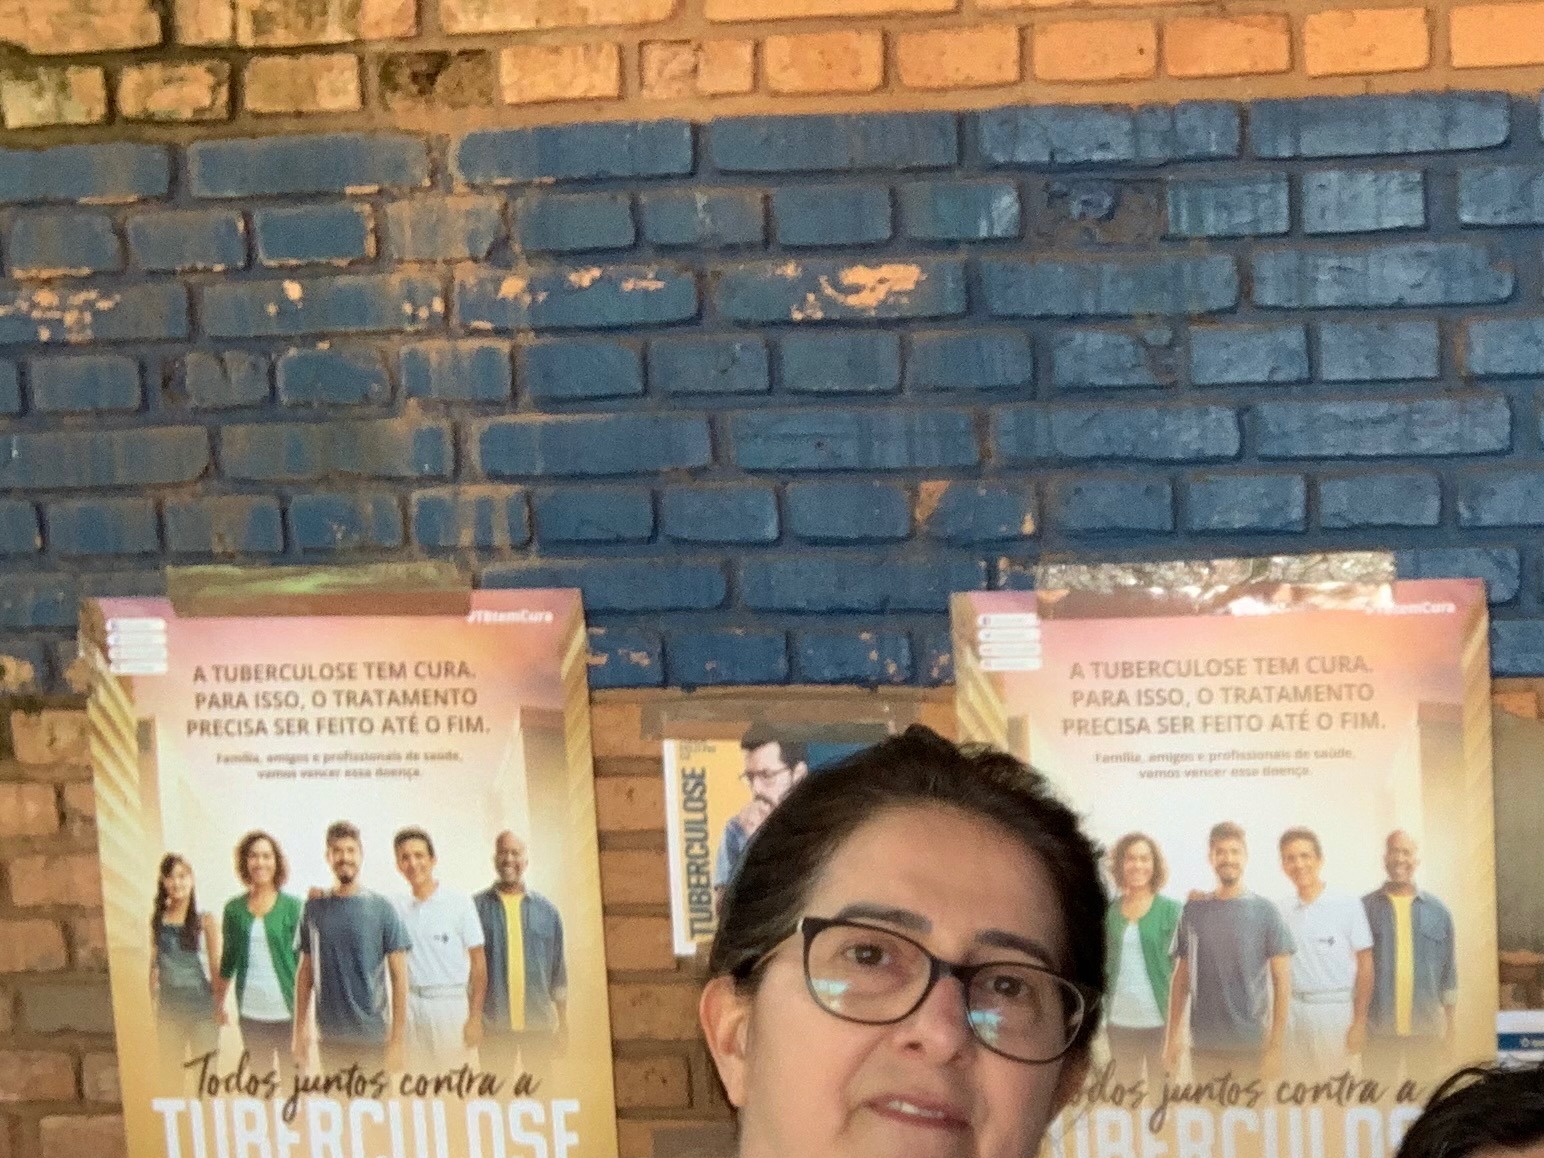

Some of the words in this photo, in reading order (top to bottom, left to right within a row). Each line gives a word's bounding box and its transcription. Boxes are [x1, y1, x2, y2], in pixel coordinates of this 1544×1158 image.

[193, 665, 206, 683] A
[212, 661, 358, 682] TUBERCULOSE
[362, 660, 407, 680] TEM
[414, 659, 476, 680] CURA.
[1069, 661, 1085, 680] A
[1090, 657, 1247, 680] TUBERCULOSE
[1253, 656, 1300, 676] TEM
[1306, 655, 1374, 675] CURA.
[195, 691, 248, 710] PARA
[255, 690, 305, 711] ISSO,
[312, 689, 326, 708] O
[333, 687, 478, 708] TRATAMENTO
[1072, 689, 1130, 708] PARA
[1136, 688, 1191, 709] ISSO,
[1197, 687, 1214, 706] O
[1219, 683, 1375, 705] TRATAMENTO
[186, 718, 268, 737] PRECISA
[273, 717, 309, 736] SER
[316, 716, 374, 736] FEITO
[382, 711, 418, 735] ATÉ
[425, 715, 440, 734] O
[447, 714, 491, 735] FIM.
[1062, 716, 1151, 737] PRECISA
[1157, 715, 1195, 735] SER
[1202, 713, 1263, 734] FEITO
[1270, 709, 1309, 732] ATÉ
[1316, 712, 1333, 731] O
[1340, 710, 1386, 731] FIM.
[681, 766, 715, 940] TUBERCULOSE
[184, 1052, 280, 1099] Todos
[283, 1059, 386, 1124] juntos
[401, 1062, 507, 1098] contra
[513, 1072, 542, 1097] a
[1149, 1070, 1266, 1134] juntos
[1277, 1070, 1385, 1106] contra
[1396, 1080, 1424, 1105] a
